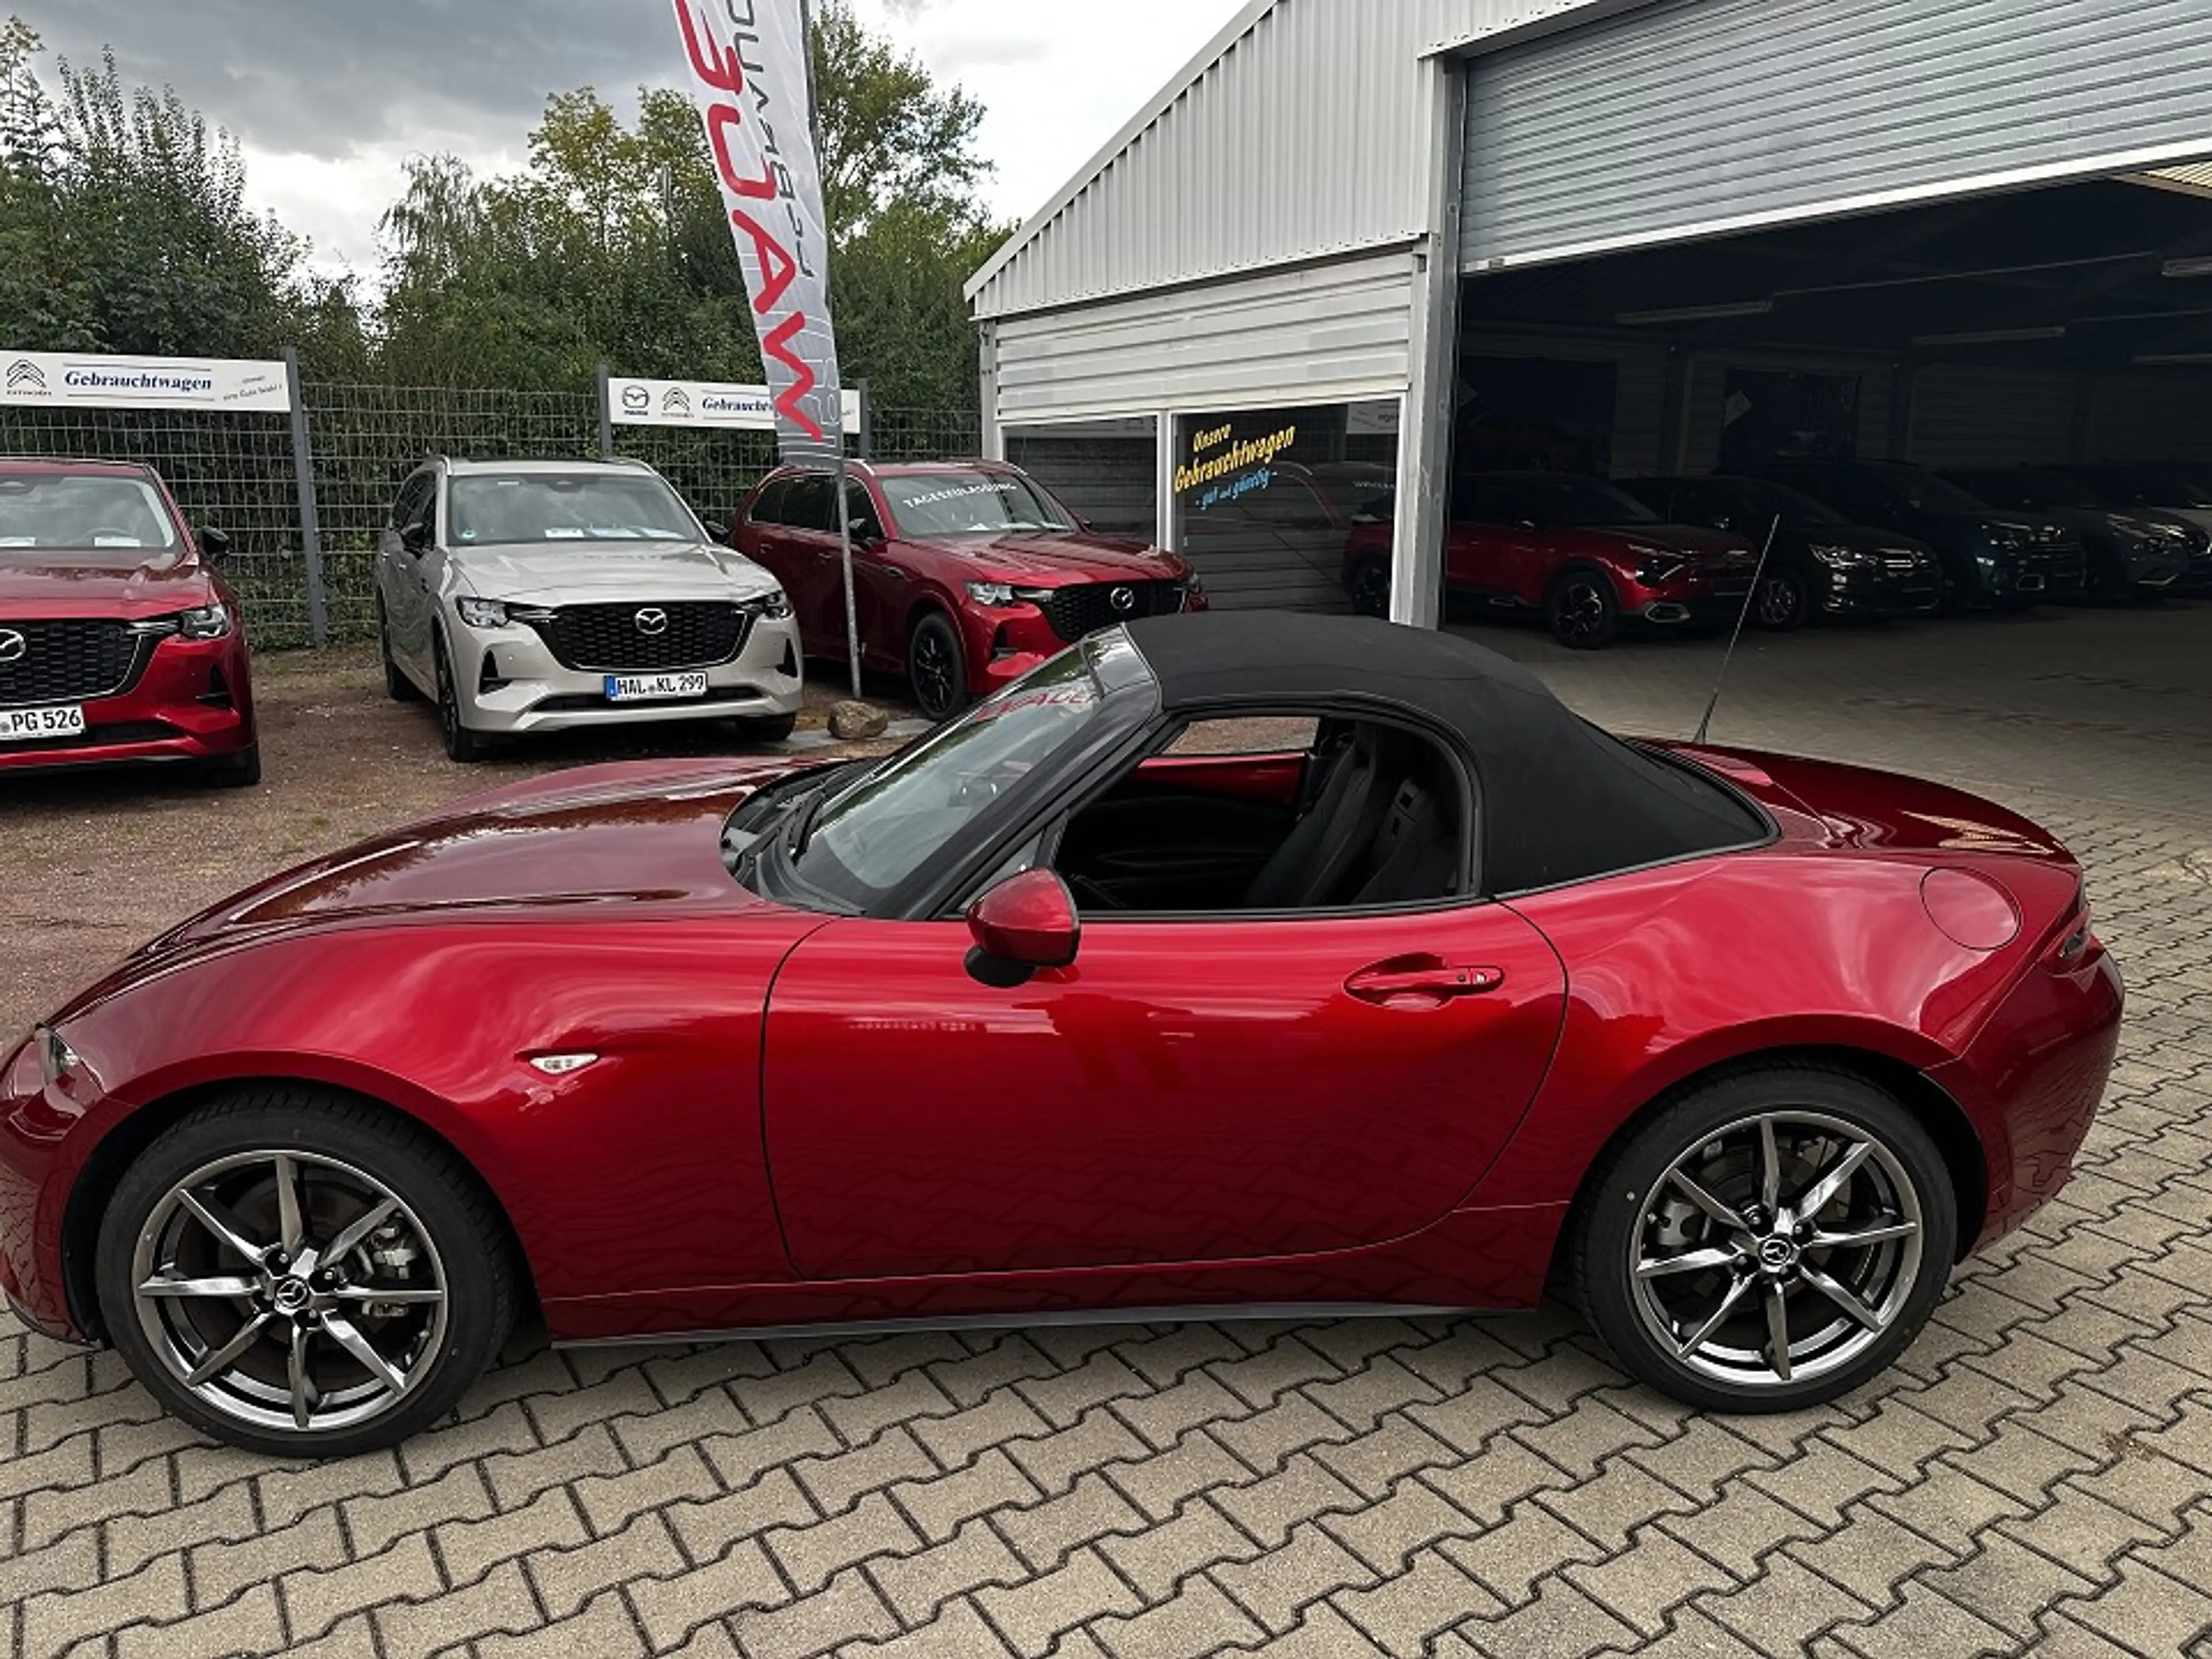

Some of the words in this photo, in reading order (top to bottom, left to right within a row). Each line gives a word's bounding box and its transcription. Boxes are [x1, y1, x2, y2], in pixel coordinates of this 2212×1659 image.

[64, 370, 212, 393] Gebrauchtwagen
[1193, 423, 1232, 452] Unsere
[1175, 425, 1296, 493] Gebrauchtwagen
[656, 677, 676, 692] KL
[677, 675, 704, 690] 299
[10, 711, 38, 731] PG
[41, 709, 82, 729] 526
